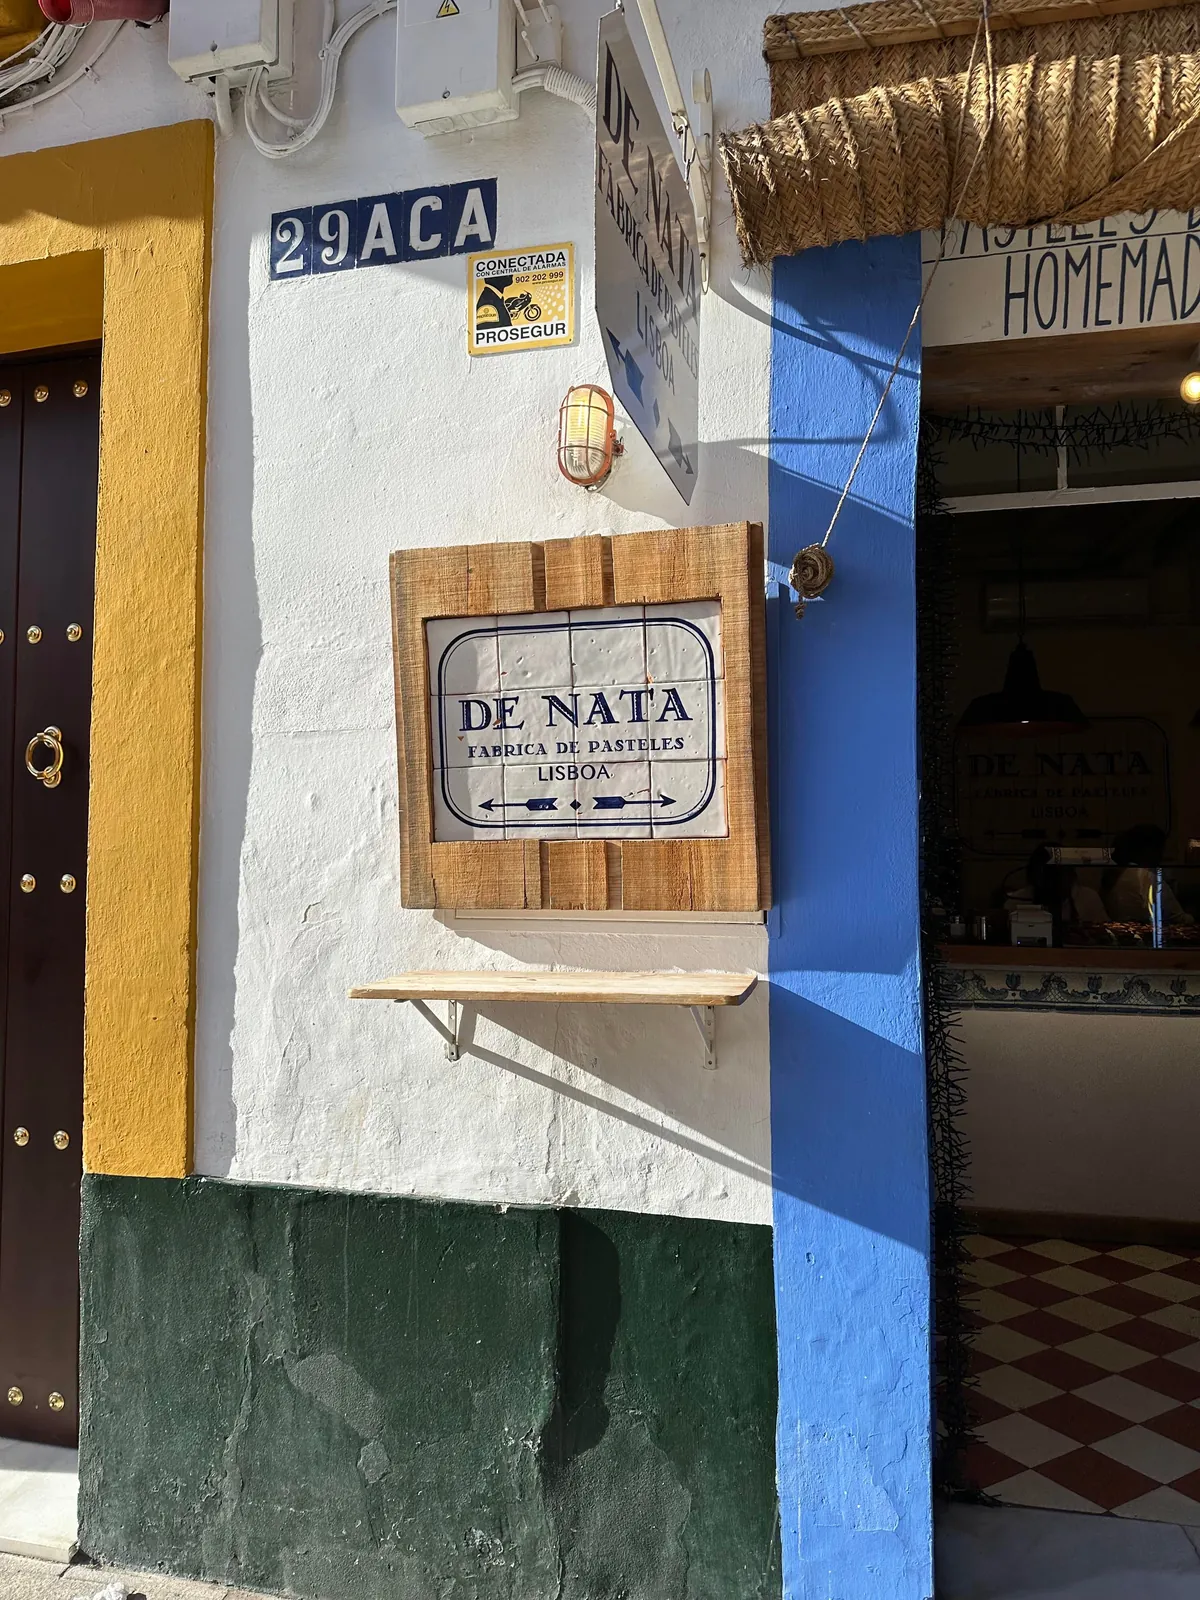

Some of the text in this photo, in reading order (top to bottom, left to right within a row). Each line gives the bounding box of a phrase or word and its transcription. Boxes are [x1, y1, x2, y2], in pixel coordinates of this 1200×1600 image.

[602, 41, 698, 326] DE NATA
[476, 251, 566, 272] CONECTADA
[492, 268, 521, 276] CENTRAL
[533, 261, 566, 270] ALARMAS
[515, 270, 564, 284] 902 202 999
[650, 256, 663, 314] DE
[664, 284, 699, 380] PASTELES
[476, 322, 566, 345] PROSEGUR
[636, 289, 676, 397] LISBOA
[458, 687, 693, 732] DE NATA
[467, 736, 685, 759] FABRICA DE PASTELES
[538, 764, 610, 782] LISBOA
[967, 751, 1152, 777] DE NATA
[1031, 806, 1089, 818] LISBOA
